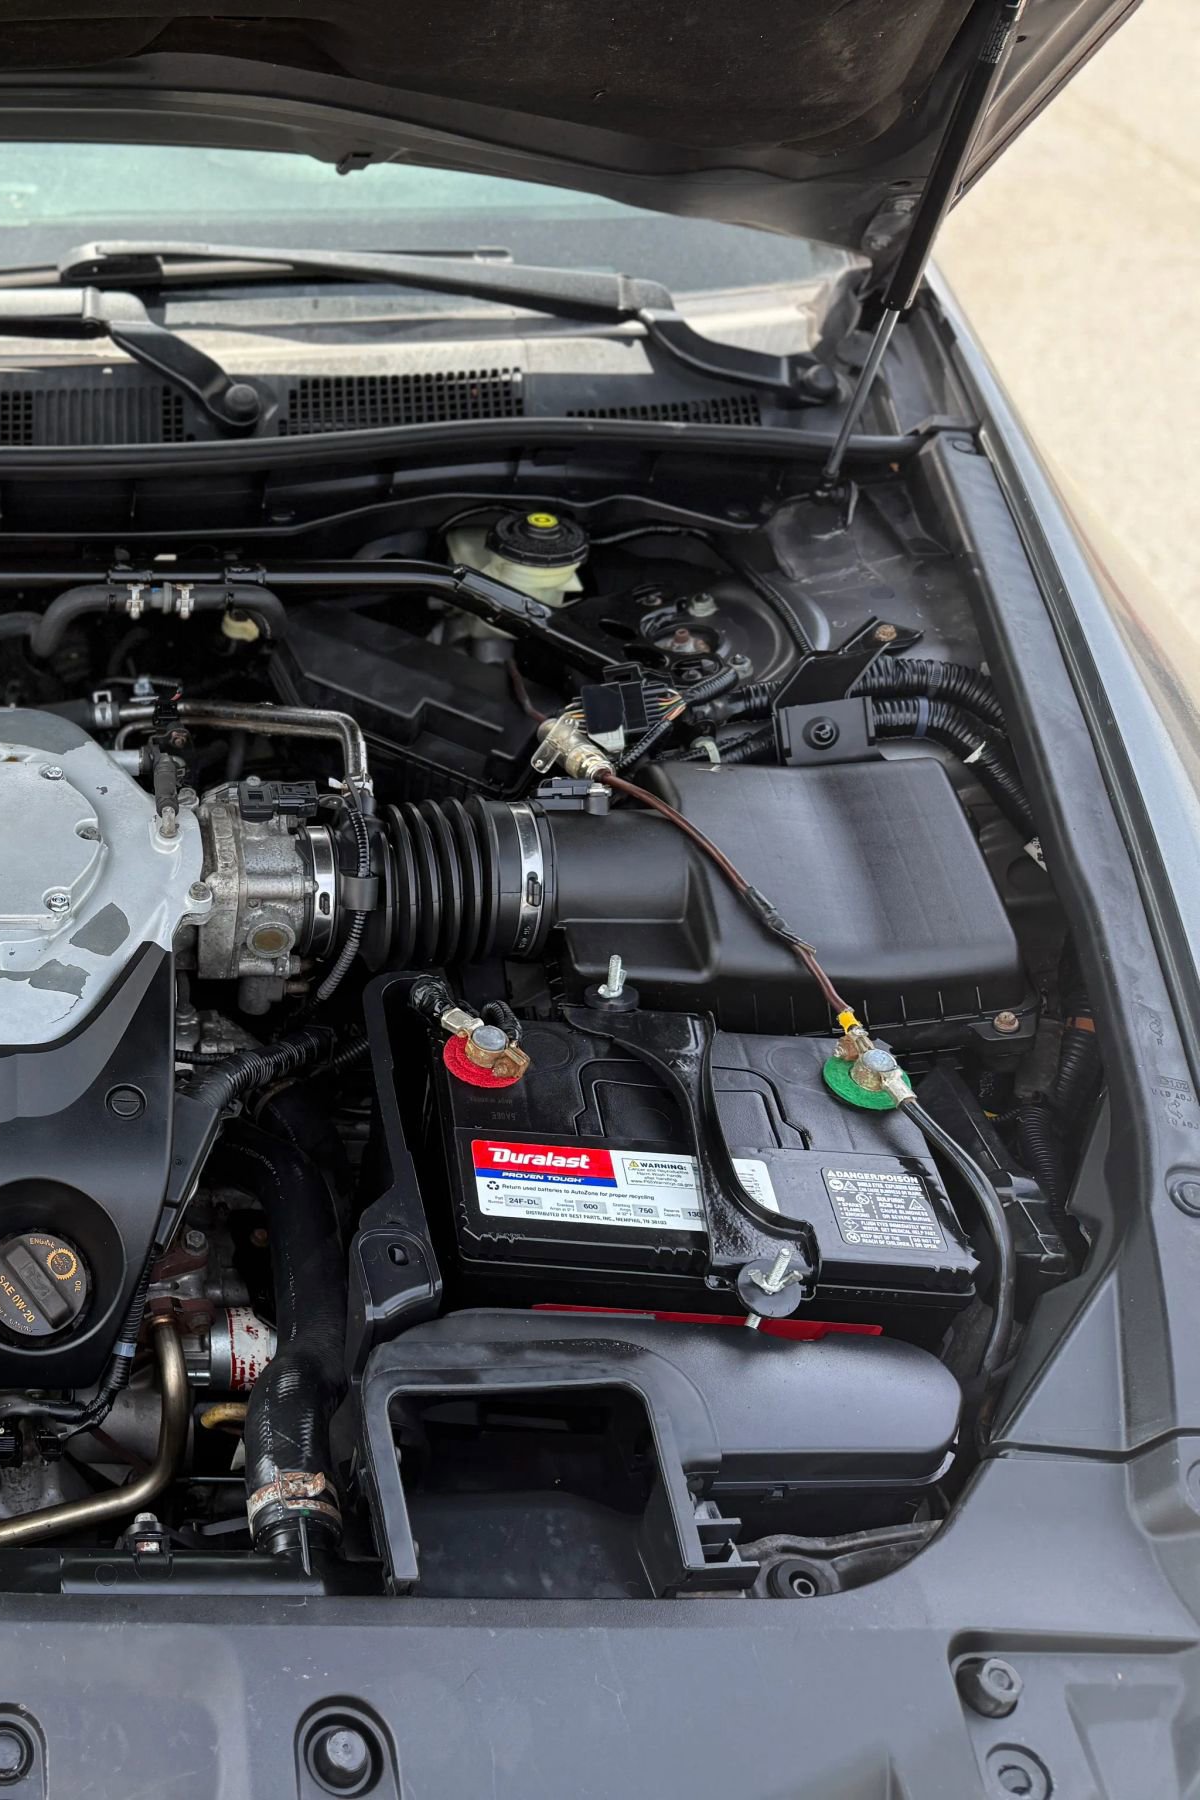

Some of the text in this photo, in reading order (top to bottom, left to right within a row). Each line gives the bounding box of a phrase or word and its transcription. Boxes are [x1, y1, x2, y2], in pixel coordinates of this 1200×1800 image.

[488, 1147, 590, 1169] Duralast
[640, 1162, 686, 1171] WARNING:
[502, 1172, 544, 1180] PROVEN
[836, 1172, 918, 1183] DANGER/POISON
[30, 1238, 56, 1248] ENGINE
[12, 1295, 36, 1323] 0W-20
